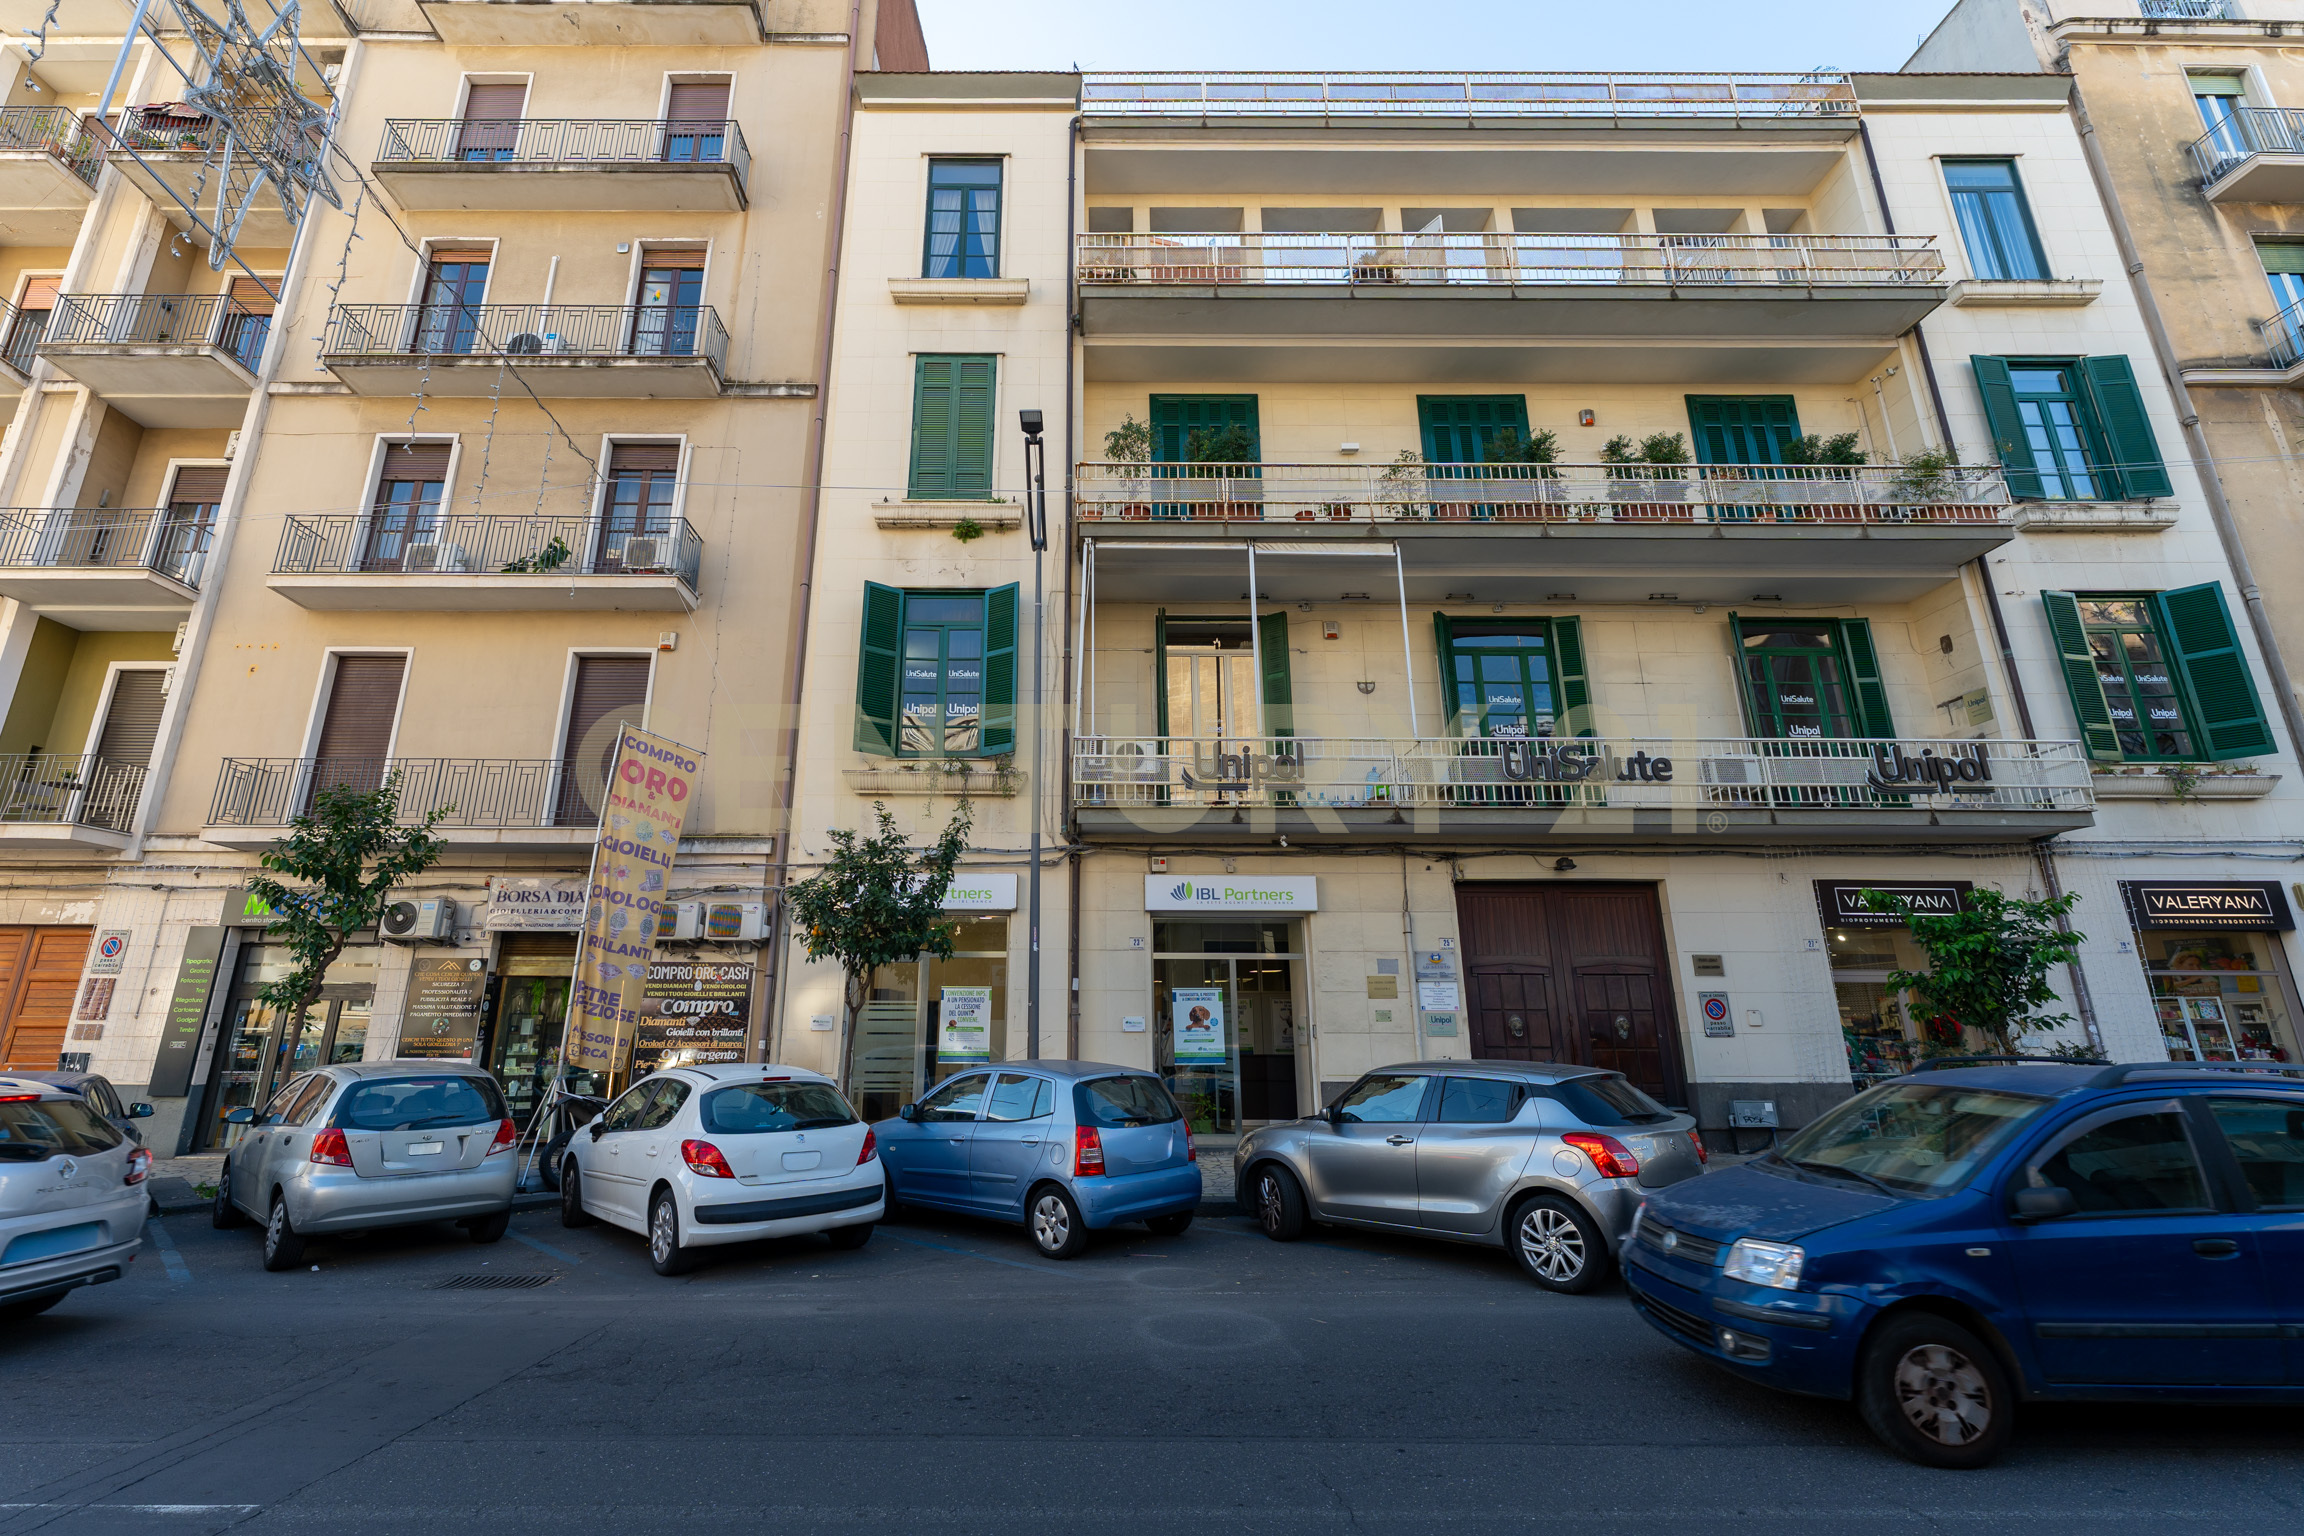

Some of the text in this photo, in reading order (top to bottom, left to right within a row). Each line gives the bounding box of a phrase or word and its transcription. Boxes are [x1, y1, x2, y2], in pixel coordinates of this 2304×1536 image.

[906, 670, 937, 678] UniSalute
[948, 670, 980, 678] UniSalute
[1488, 696, 1521, 704] UniSalute
[1780, 695, 1814, 703] UniSalute
[1967, 695, 1986, 707] Unipol
[906, 703, 937, 717] Unipol
[949, 703, 980, 717] Unipol
[2109, 708, 2133, 718] Unipol
[2152, 708, 2177, 718] Unipol
[1495, 724, 1525, 736] Unipol
[1790, 724, 1821, 738] Unipol
[624, 735, 697, 774] COMPRO
[1193, 741, 1306, 791] Unipol
[1501, 743, 1673, 782] UniSalute
[1871, 745, 1993, 794] Unipol
[620, 758, 688, 802] ORO
[648, 791, 655, 801] &
[610, 793, 681, 829] DIAMANTI
[602, 835, 671, 870] GIOIELLI
[496, 890, 586, 903] BORSA DIA
[592, 884, 663, 916] OROLOGI
[1196, 887, 1294, 901] IBL Partners
[2150, 895, 2263, 909] VALERYANA
[587, 935, 653, 961] RILLANTI
[647, 966, 693, 980] COMPRO
[721, 966, 749, 980] CASH
[660, 998, 735, 1017] Compro
[639, 1016, 686, 1026] Diamanti
[1430, 1015, 1452, 1025] Unipol
[665, 1027, 744, 1037] Gioielli con brillanti
[618, 1038, 630, 1048] DI
[638, 1039, 666, 1048] Orologi
[666, 1040, 674, 1048] &
[676, 1039, 710, 1048] Accessori
[711, 1039, 718, 1048] di
[697, 1050, 738, 1061] argento
